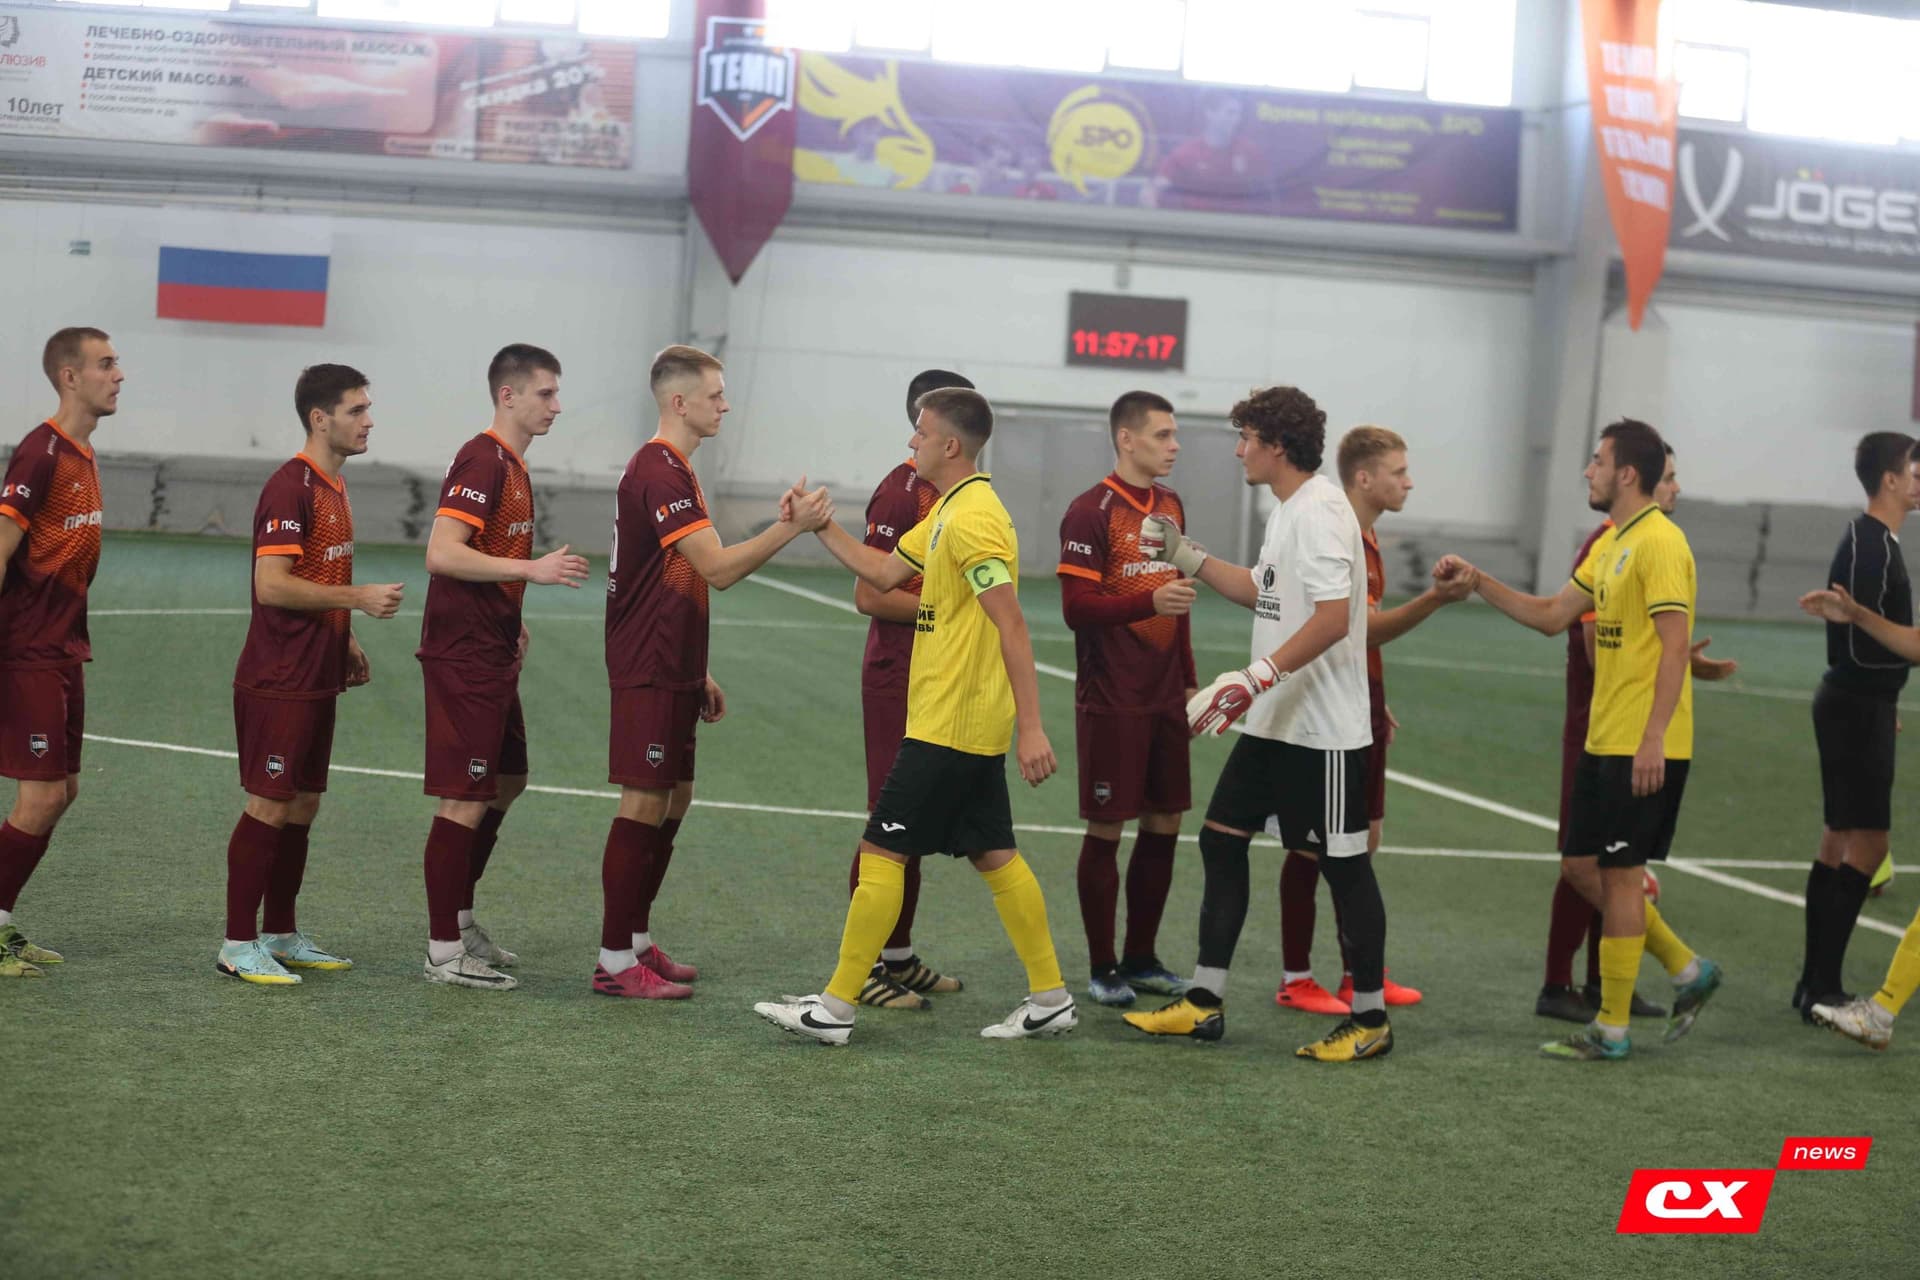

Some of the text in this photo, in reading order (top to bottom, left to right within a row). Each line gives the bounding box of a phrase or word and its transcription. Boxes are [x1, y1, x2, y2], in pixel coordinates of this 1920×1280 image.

[83, 65, 163, 84] ДЕТСКИЙ
[709, 53, 785, 99] ТЕМП
[1073, 329, 1177, 361] 11:57:17
[461, 487, 487, 504] ПСБ
[1068, 541, 1092, 555] ПСБ
